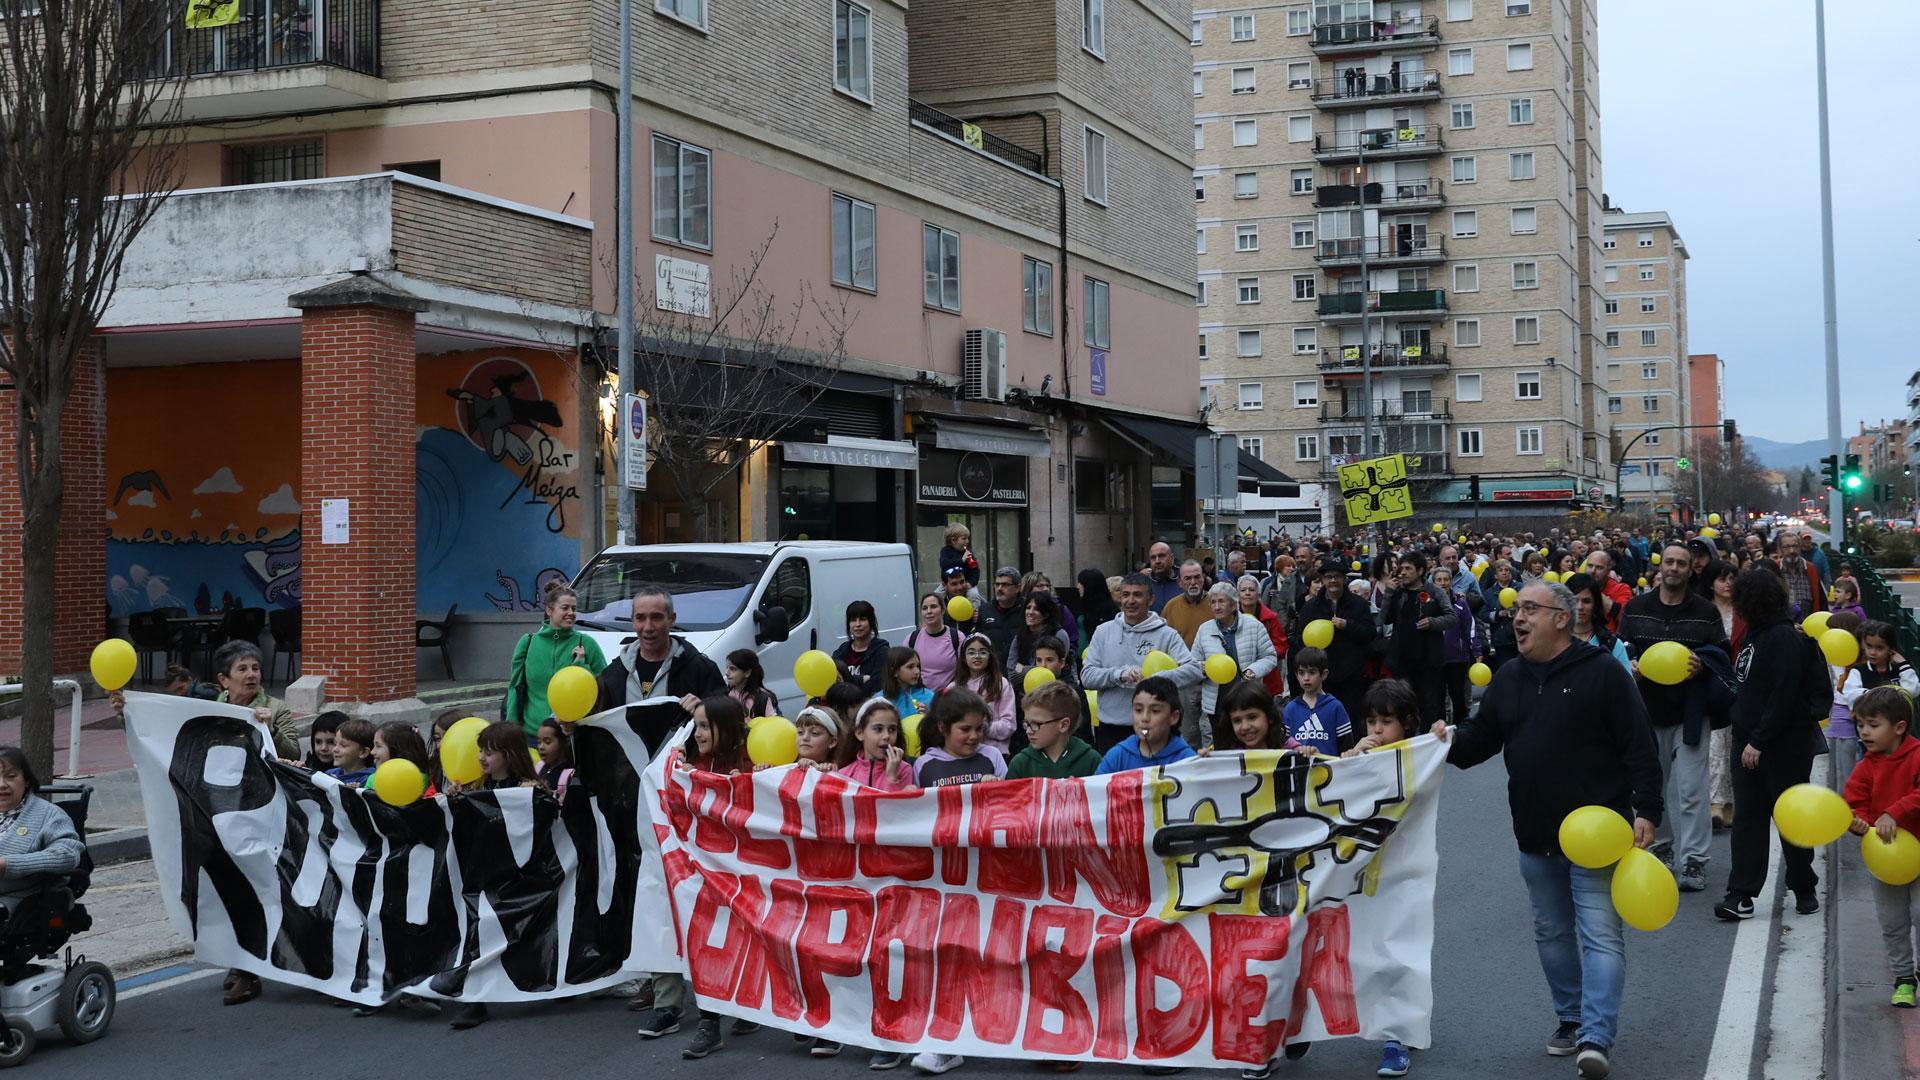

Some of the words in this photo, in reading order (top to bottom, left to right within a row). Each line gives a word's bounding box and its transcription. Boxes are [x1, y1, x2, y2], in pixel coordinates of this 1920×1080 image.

[539, 437, 573, 468] Bar
[921, 483, 958, 498] PANADERIA
[991, 488, 1026, 500] PASTELERIA
[1294, 729, 1329, 741] adidas
